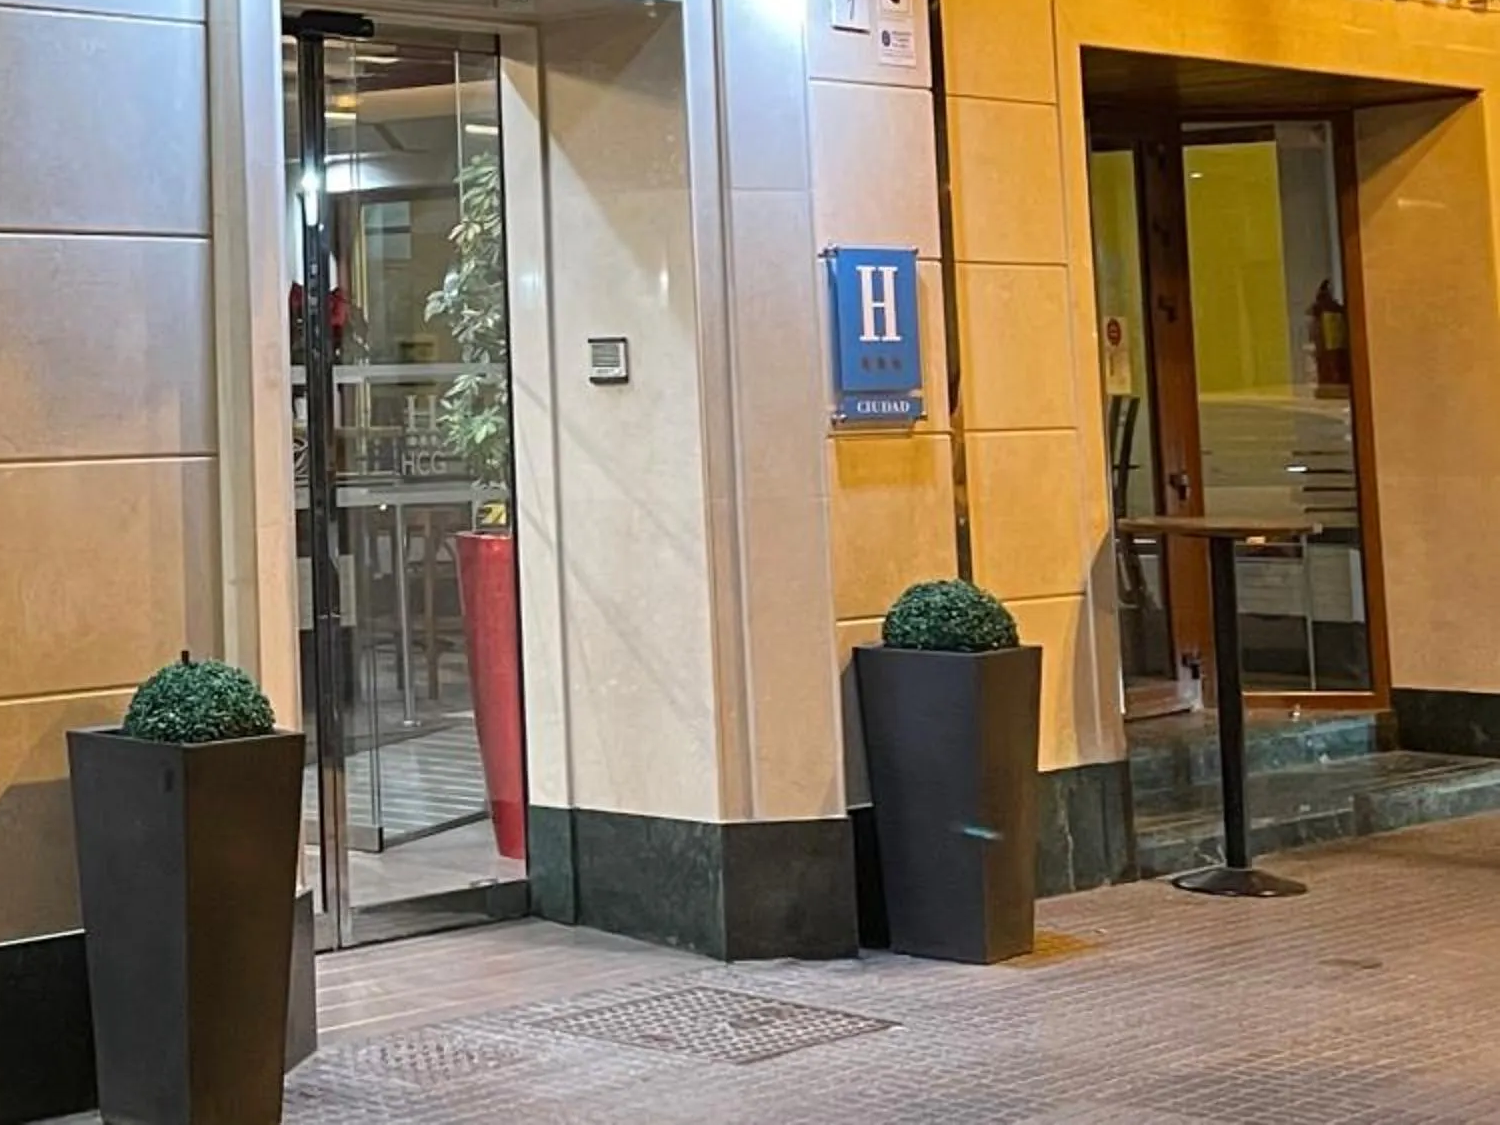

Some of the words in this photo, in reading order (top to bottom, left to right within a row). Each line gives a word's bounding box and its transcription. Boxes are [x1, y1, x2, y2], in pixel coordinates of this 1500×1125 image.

[856, 265, 902, 342] H
[857, 400, 910, 413] CIUDAD
[401, 450, 448, 475] HCG
